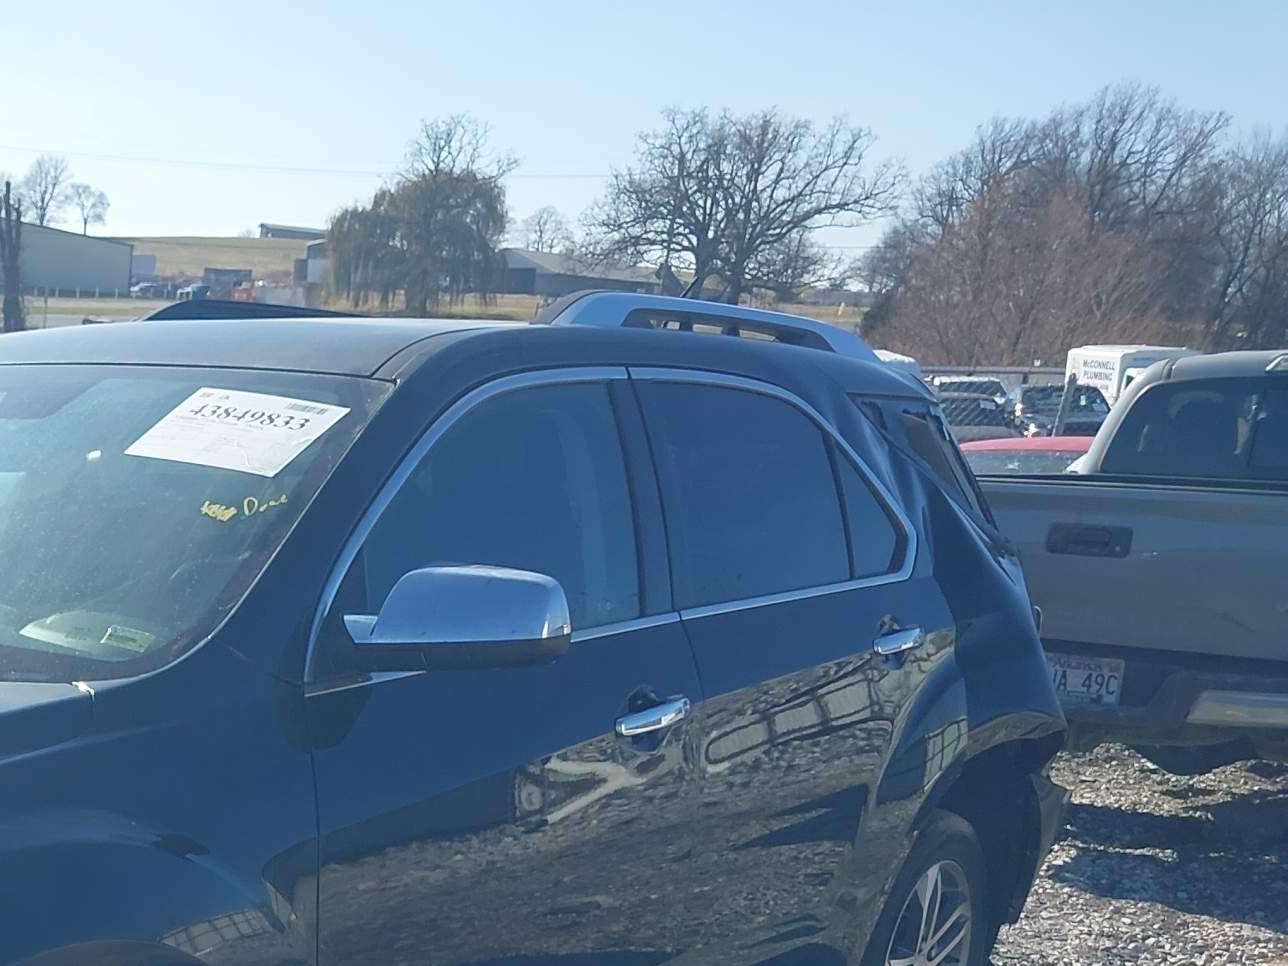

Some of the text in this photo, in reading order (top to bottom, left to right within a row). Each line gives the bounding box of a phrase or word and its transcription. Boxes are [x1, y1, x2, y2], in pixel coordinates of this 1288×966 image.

[1083, 370, 1113, 381] PLUMBING
[189, 403, 311, 431] 43849833
[1081, 672, 1118, 695] 49C
